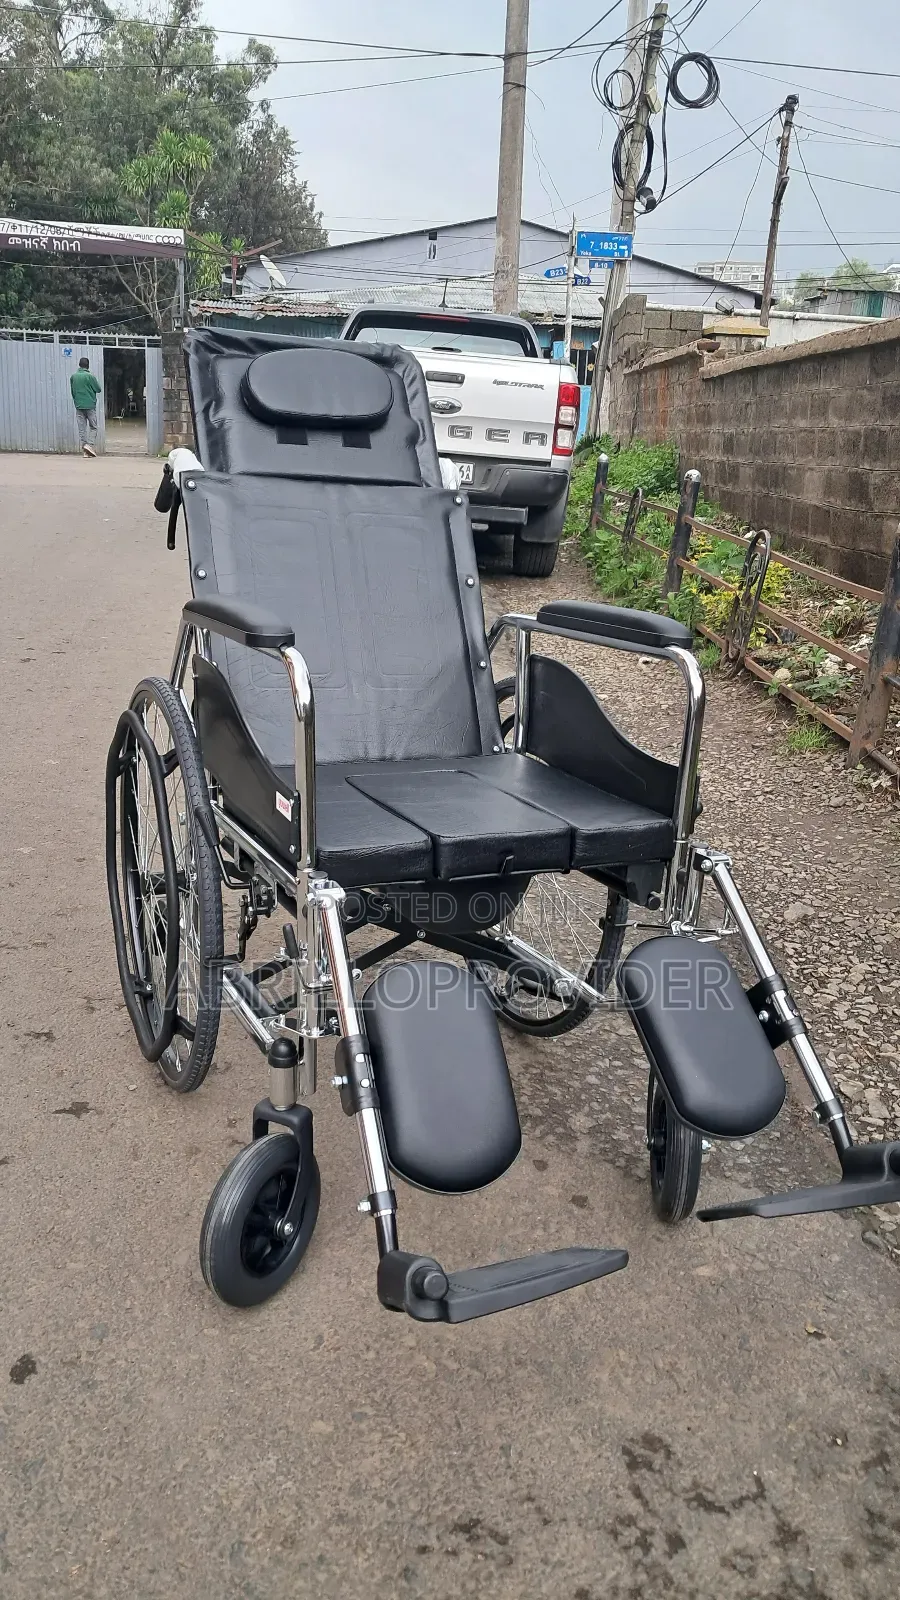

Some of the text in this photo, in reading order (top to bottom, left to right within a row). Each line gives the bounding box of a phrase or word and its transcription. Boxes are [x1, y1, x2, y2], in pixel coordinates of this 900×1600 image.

[549, 269, 564, 277] B23
[434, 400, 452, 411] Ford
[433, 423, 548, 447] GER
